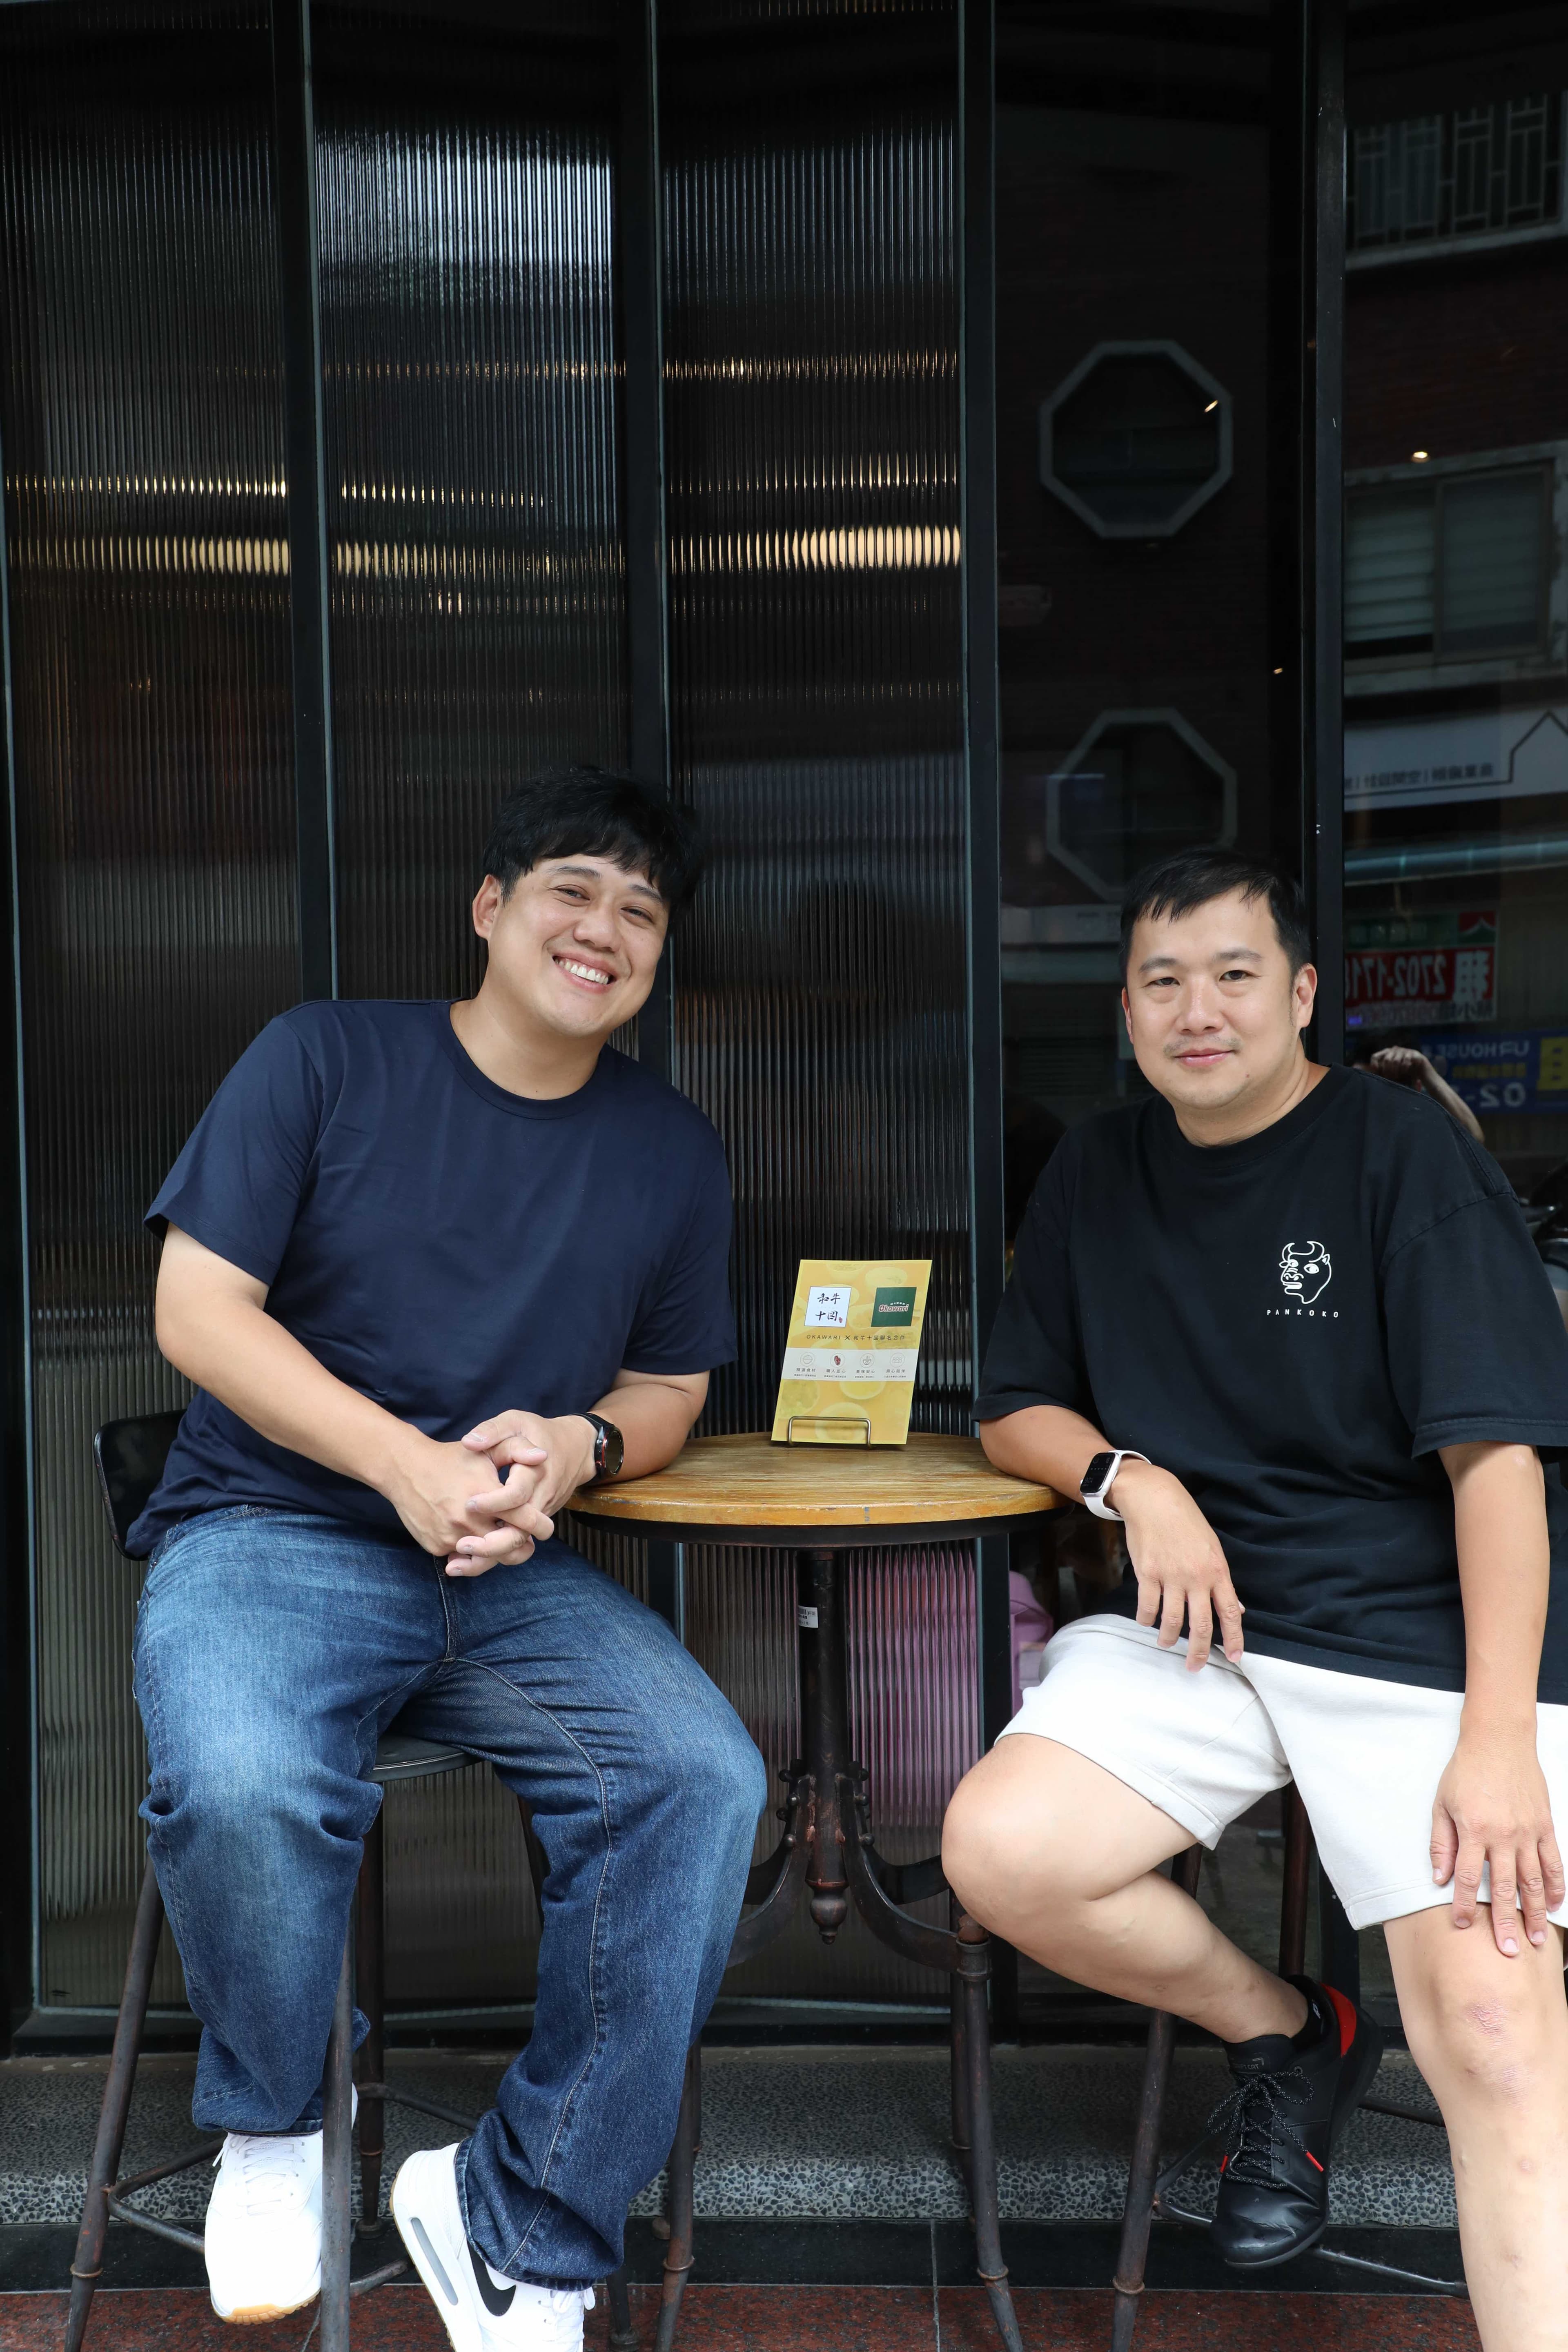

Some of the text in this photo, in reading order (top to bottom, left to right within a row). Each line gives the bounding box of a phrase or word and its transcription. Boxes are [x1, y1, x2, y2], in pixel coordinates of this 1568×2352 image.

[817, 1293, 840, 1305] 和牛
[878, 1304, 909, 1312] Okawari
[1267, 1309, 1339, 1318] PANKOKO
